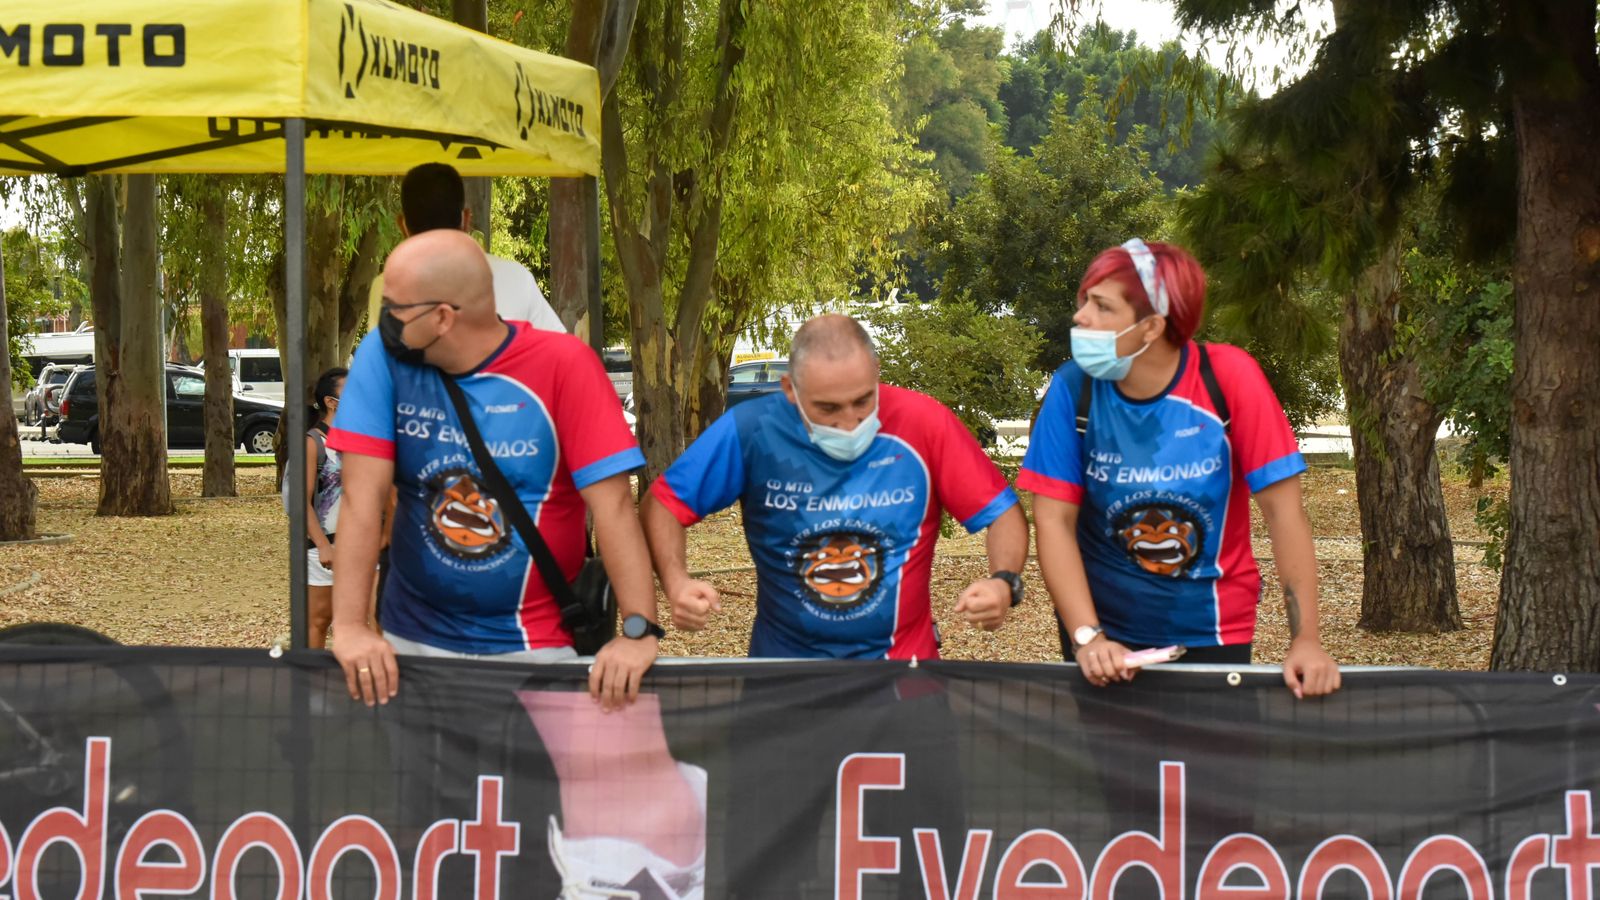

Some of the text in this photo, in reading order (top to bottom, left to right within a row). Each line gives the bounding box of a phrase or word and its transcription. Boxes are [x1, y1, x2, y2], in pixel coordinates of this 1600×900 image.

[370, 34, 440, 89] XLMOTO
[534, 88, 586, 137] XLMOTO
[397, 402, 446, 421] CD MTB
[397, 416, 432, 439] LOS
[1096, 452, 1122, 465] MTB
[1116, 455, 1222, 483] ENMONAOS
[766, 479, 813, 494] CD MTB
[764, 485, 915, 512] LOS ENMONAOS
[1125, 490, 1153, 504] LOS
[814, 518, 841, 532] LOS
[453, 563, 466, 571] LA
